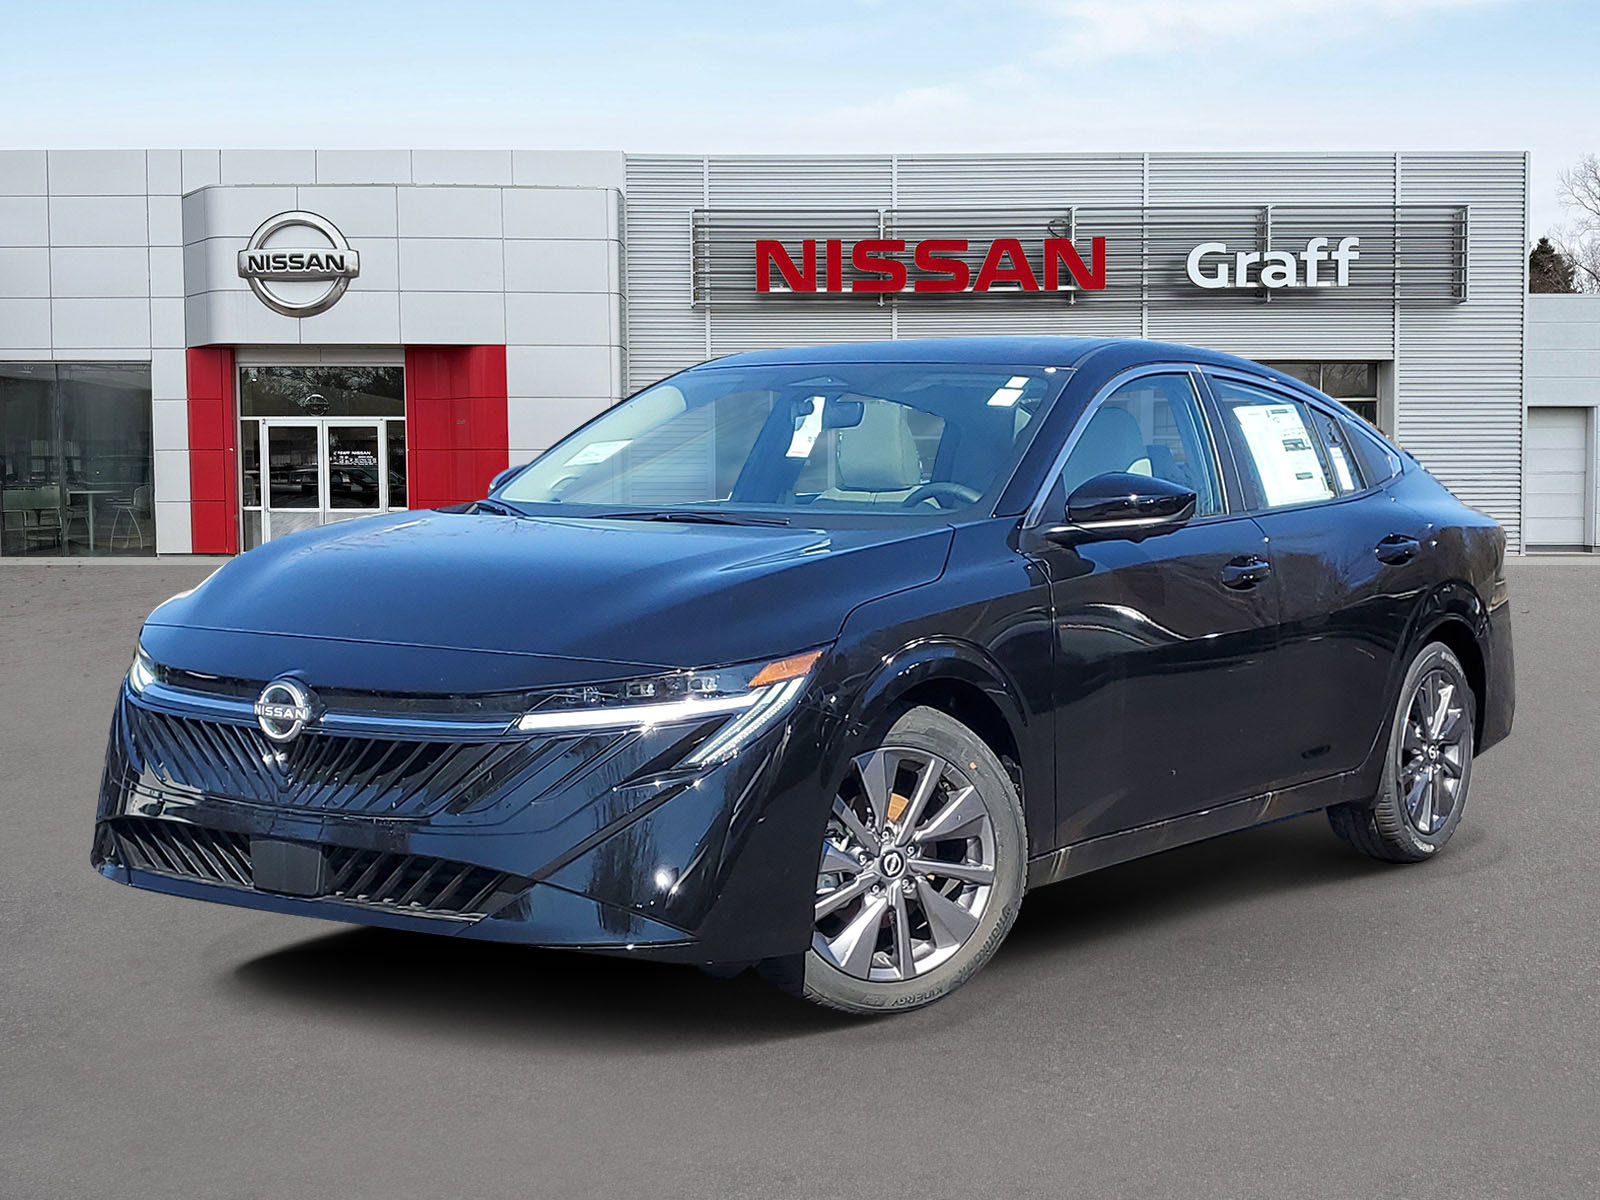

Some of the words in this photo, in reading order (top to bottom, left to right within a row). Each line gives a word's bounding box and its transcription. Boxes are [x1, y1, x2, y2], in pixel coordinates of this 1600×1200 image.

[248, 253, 345, 271] NISSAN
[755, 237, 1106, 292] NISSAN
[1186, 237, 1360, 288] Graff
[254, 704, 306, 719] NISSAN
